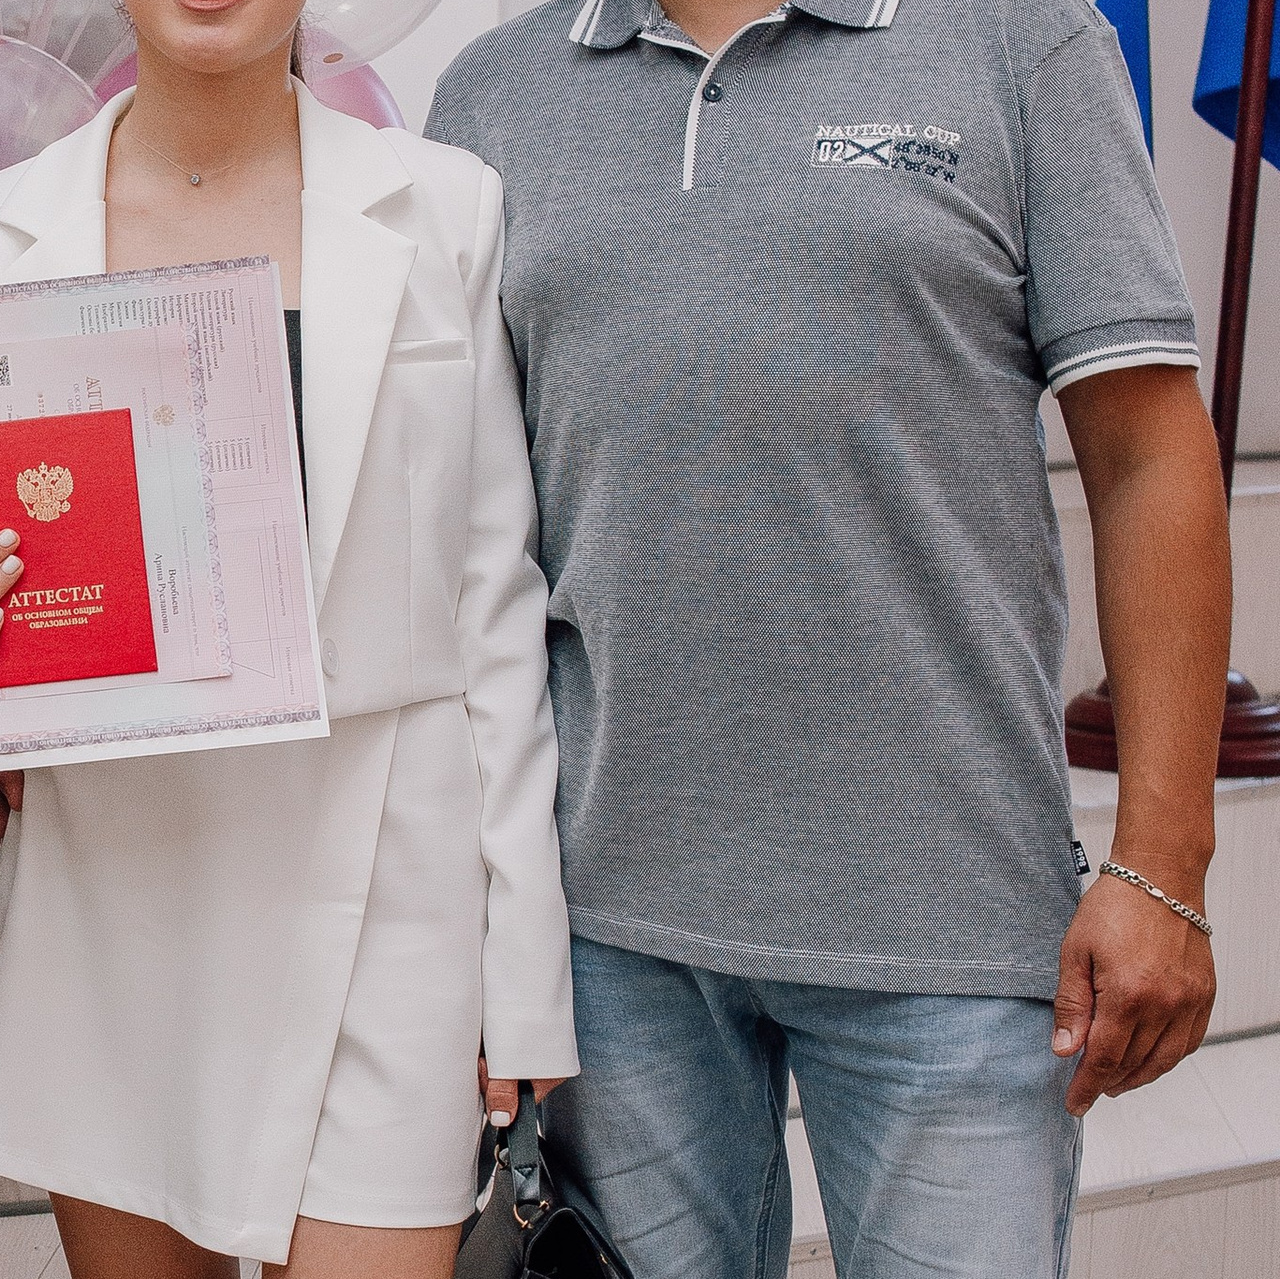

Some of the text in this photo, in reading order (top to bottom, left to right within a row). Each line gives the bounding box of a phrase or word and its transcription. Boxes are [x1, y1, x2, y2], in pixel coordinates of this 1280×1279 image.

[815, 124, 961, 146] NAUTICAL CUP
[820, 141, 844, 162] 02
[8, 584, 105, 608] АТТЕСТАТ
[152, 552, 170, 634] Арина Руслановна
[166, 568, 181, 615] Воробьева
[11, 605, 104, 622] ОБ ОСНОВНОМ ОБЩЕМ
[29, 616, 88, 629] ОБРАЗОВАНИИ
[1075, 847, 1087, 867] 1998
